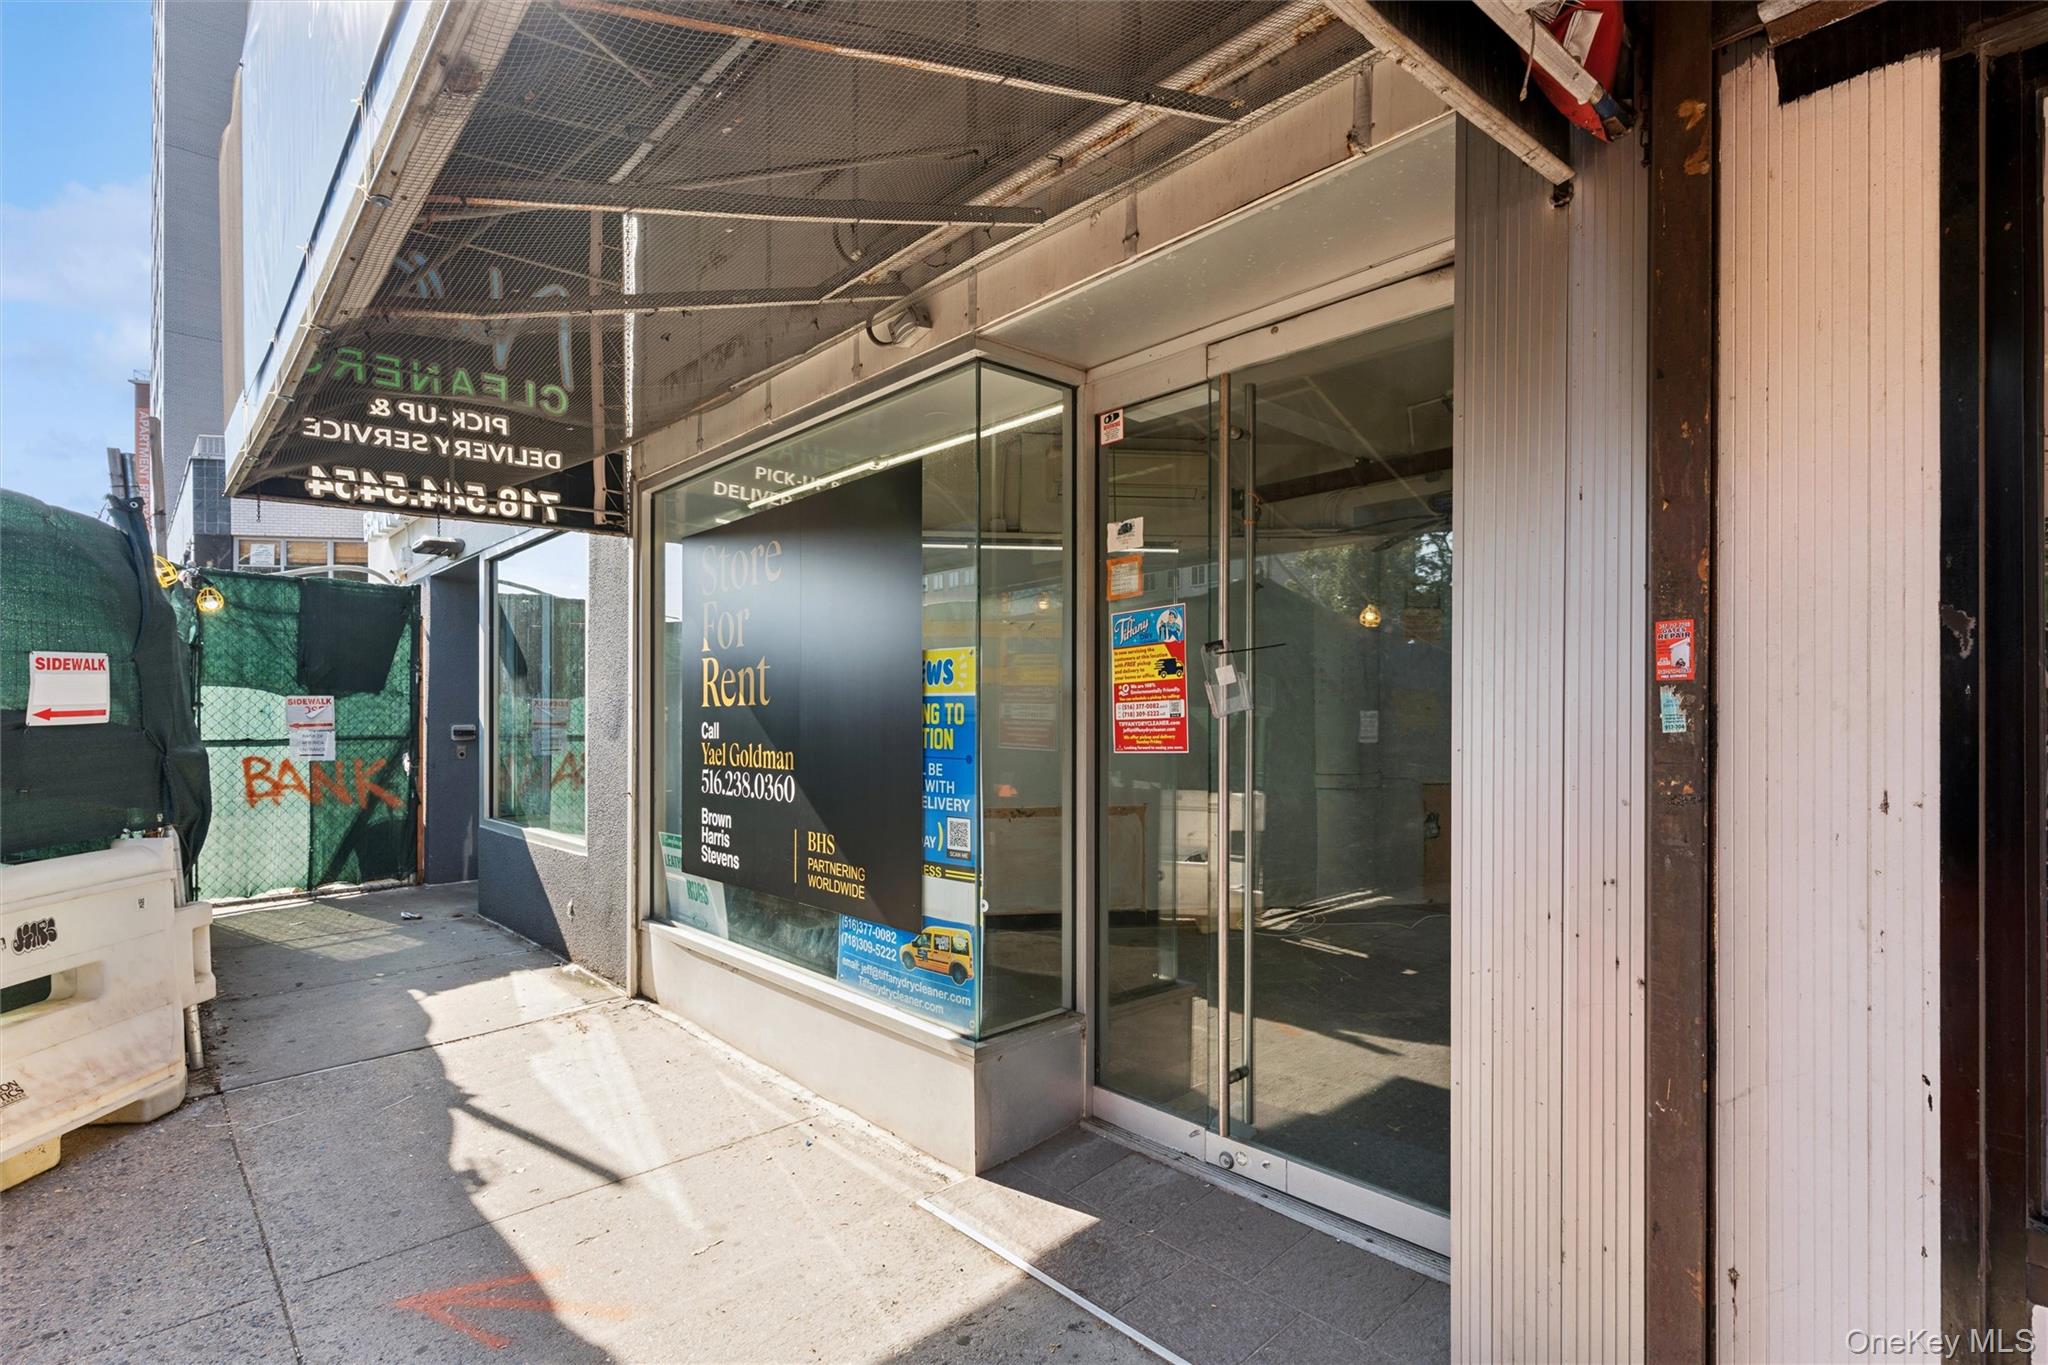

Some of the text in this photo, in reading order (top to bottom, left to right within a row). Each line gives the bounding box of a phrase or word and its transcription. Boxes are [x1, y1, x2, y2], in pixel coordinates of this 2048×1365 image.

[701, 539, 783, 597] Store
[701, 601, 750, 653] For
[1658, 631, 1690, 640] REPAIR
[35, 656, 106, 671] SIDEWALK
[701, 655, 772, 708] Rent
[945, 703, 965, 725] TO
[701, 722, 719, 739] Call
[701, 742, 795, 770] Yael Goldman
[242, 755, 404, 809] BANK
[928, 763, 943, 777] BE
[701, 769, 796, 803] 516.238.0360
[925, 780, 955, 795] WITH
[701, 808, 732, 828] Brown
[701, 827, 731, 848] Harris
[807, 831, 836, 855] BHS
[701, 845, 740, 870] Stevens
[807, 857, 866, 881] PARTNERING
[807, 874, 866, 900] WORLDWIDE
[841, 915, 897, 944] (516)377-0082
[841, 932, 897, 962] (718)309-5222
